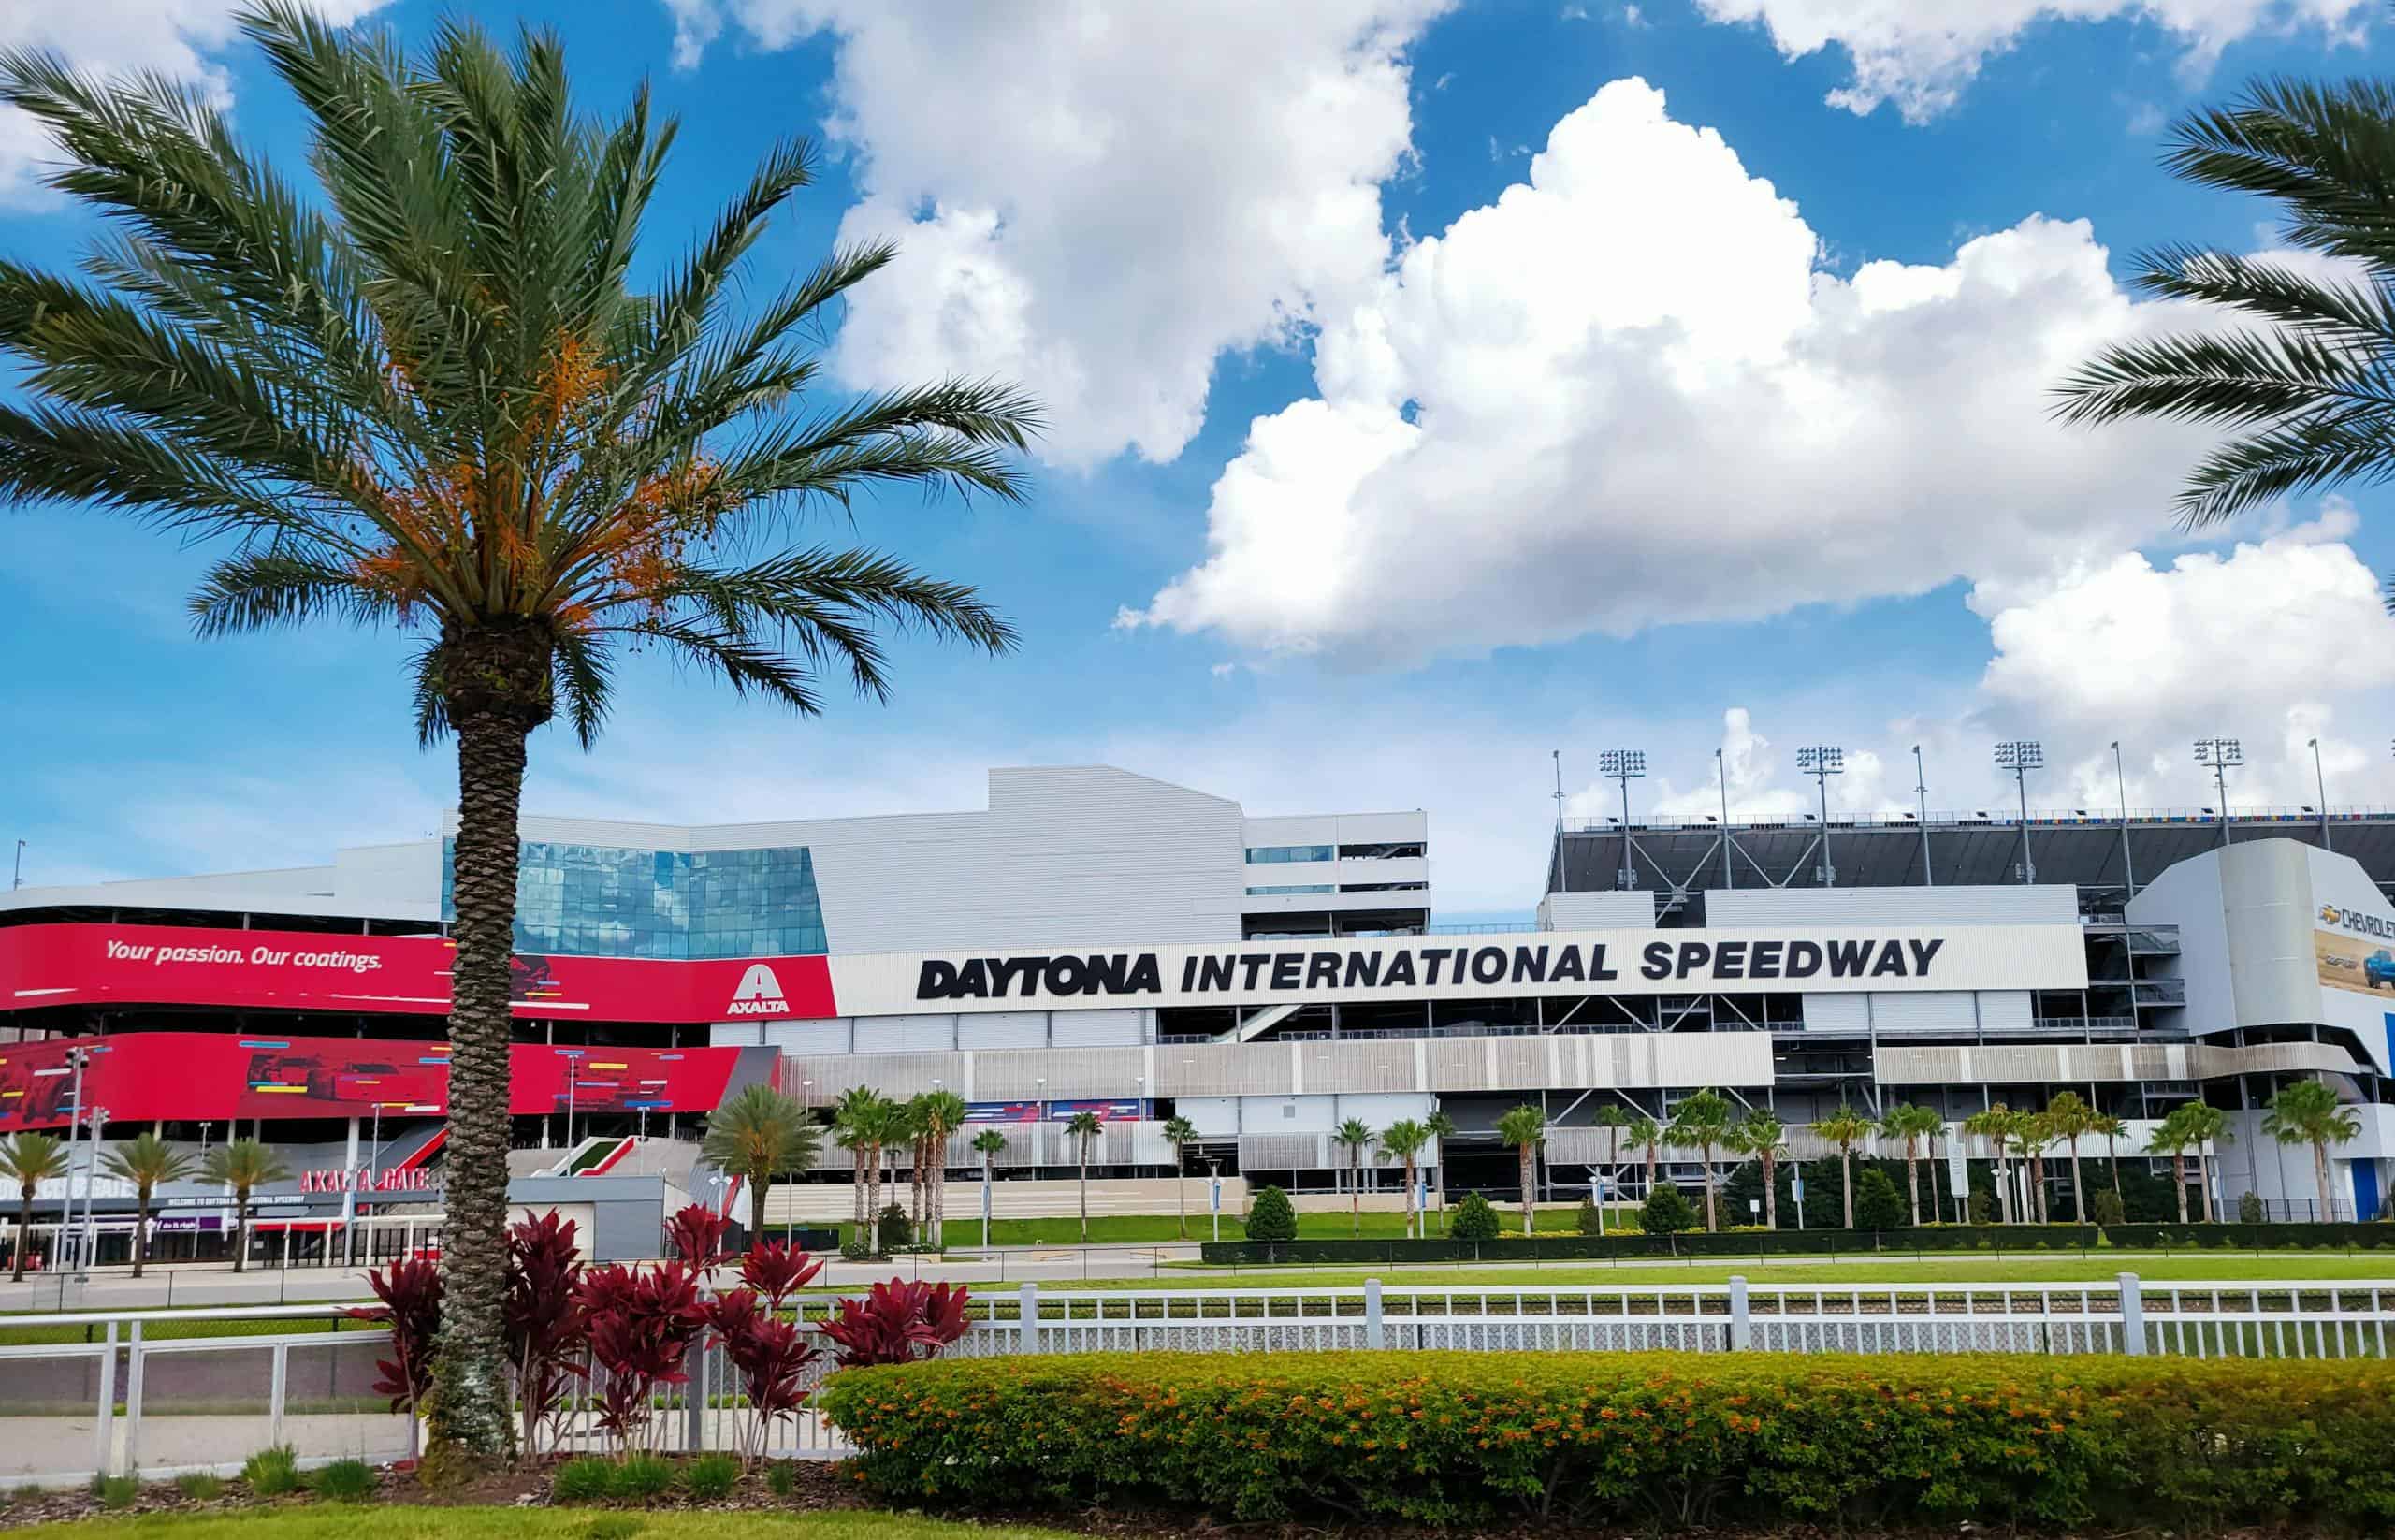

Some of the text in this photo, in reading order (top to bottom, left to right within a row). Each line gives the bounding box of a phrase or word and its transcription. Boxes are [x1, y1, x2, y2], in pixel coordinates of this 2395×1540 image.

[106, 939, 383, 973] Your passion. Our coatings.
[917, 938, 1945, 999] DAYTONA INTERNATIONAL SPEEDWAY
[727, 1000, 791, 1015] AXALTA
[299, 1168, 430, 1193] AXALA GATE
